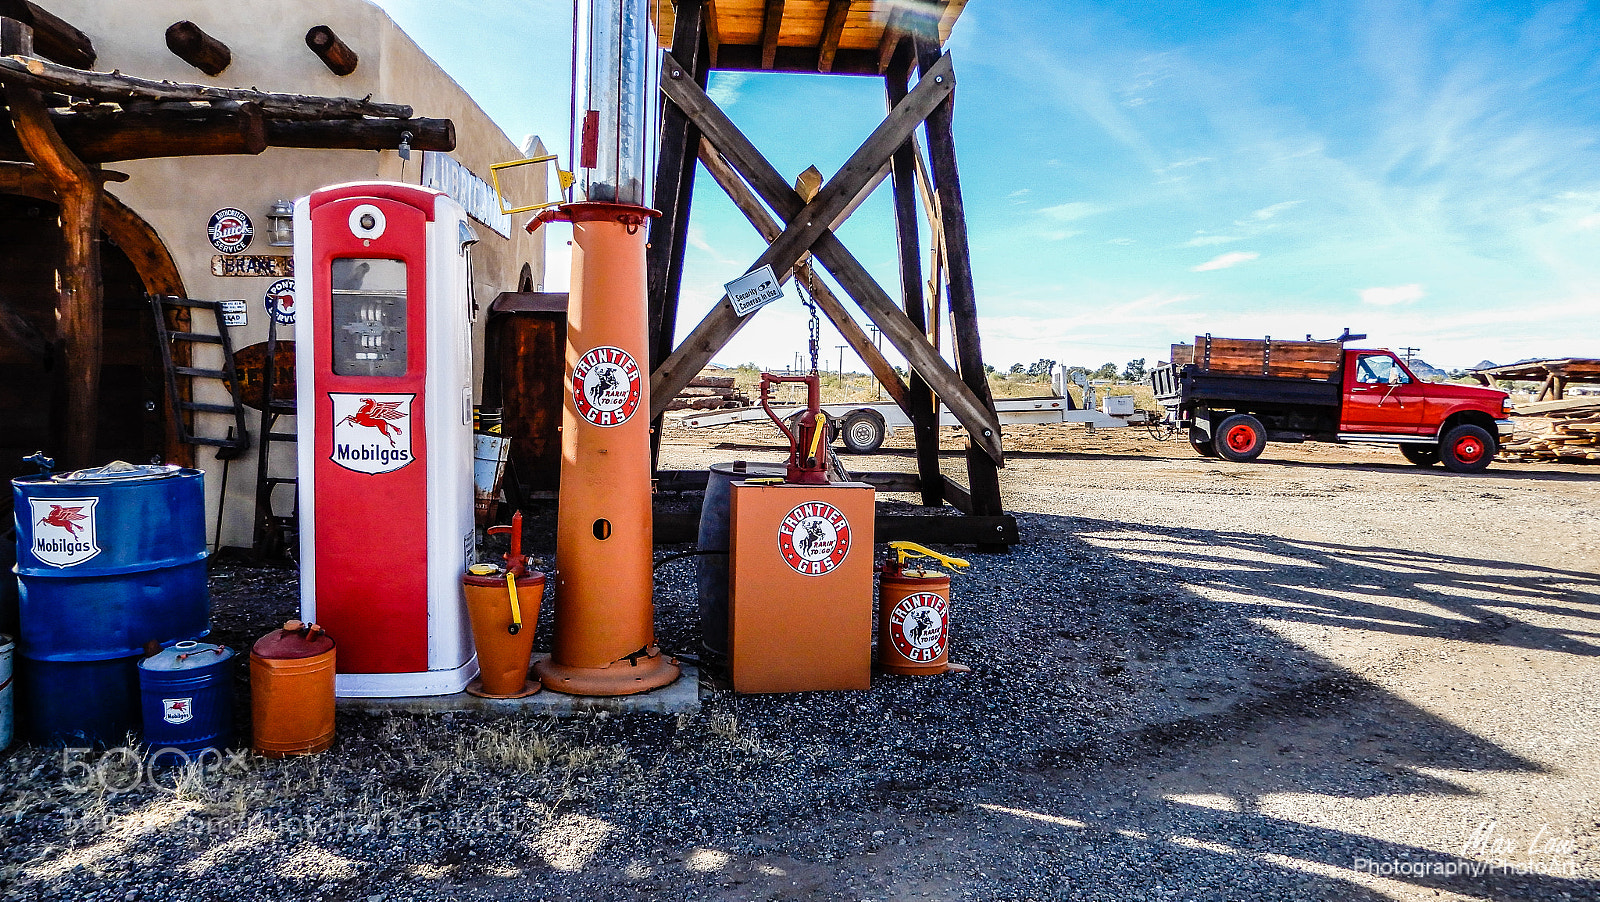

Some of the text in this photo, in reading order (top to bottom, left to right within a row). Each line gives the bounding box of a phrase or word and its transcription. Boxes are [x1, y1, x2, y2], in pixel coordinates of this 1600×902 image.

[213, 220, 249, 241] Buick
[214, 241, 246, 253] SERVICE
[225, 258, 276, 275] BRAKE
[270, 281, 296, 294] PONT
[735, 289, 757, 302] Security
[268, 306, 296, 322] SRVI
[575, 349, 639, 382] FRONTIER
[586, 407, 626, 425] GAS
[337, 443, 409, 465] Mobilgas
[780, 504, 847, 536] FRONTIER
[37, 537, 91, 556] Mobilgas
[797, 557, 835, 574] GAS
[891, 595, 947, 626] FRONTIER
[909, 643, 942, 661] GAS
